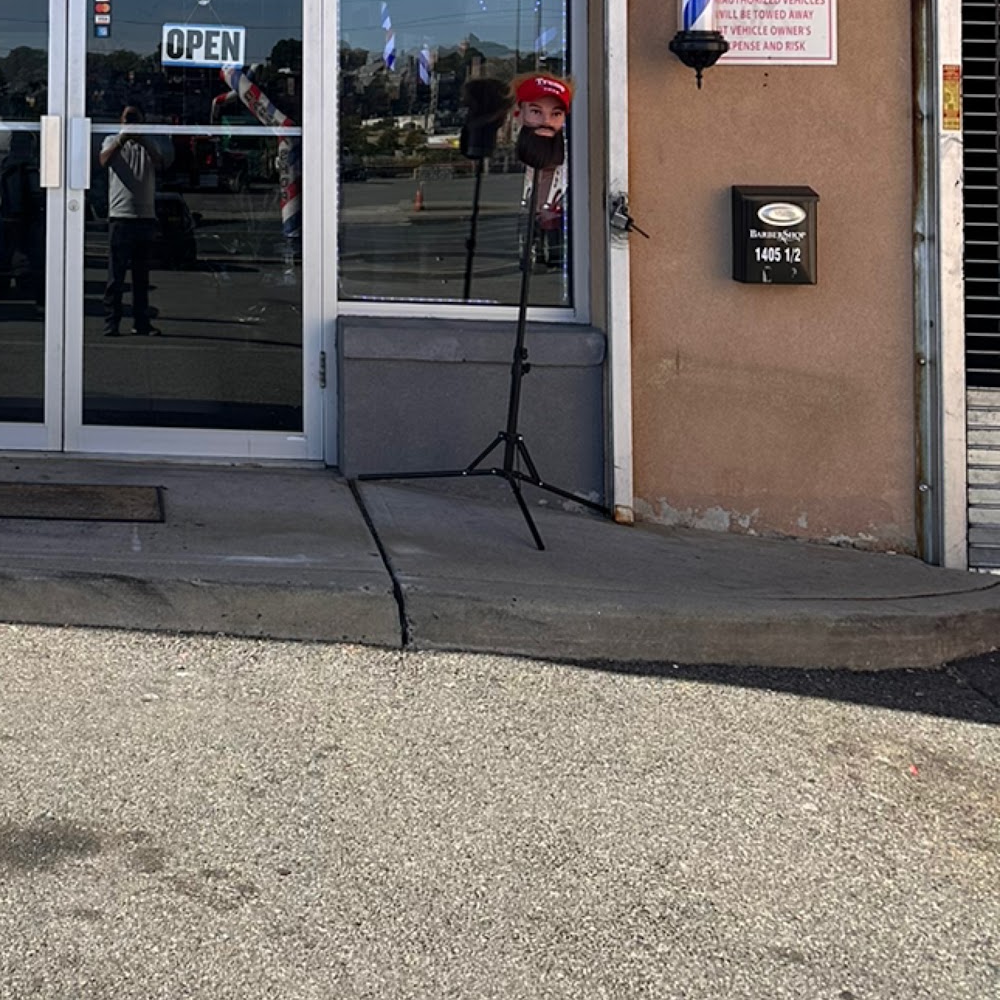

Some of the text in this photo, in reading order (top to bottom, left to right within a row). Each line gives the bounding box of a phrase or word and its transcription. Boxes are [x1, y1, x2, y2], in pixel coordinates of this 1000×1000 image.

[740, 9, 751, 19] BE
[753, 9, 786, 19] TOWED
[788, 9, 814, 19] AWAY
[730, 26, 768, 36] VEHICLE
[770, 26, 812, 36] OWNER'S
[167, 28, 240, 61] OPEN
[762, 41, 783, 51] AND
[785, 41, 806, 51] RISK
[755, 246, 801, 264] 1405 1/2
